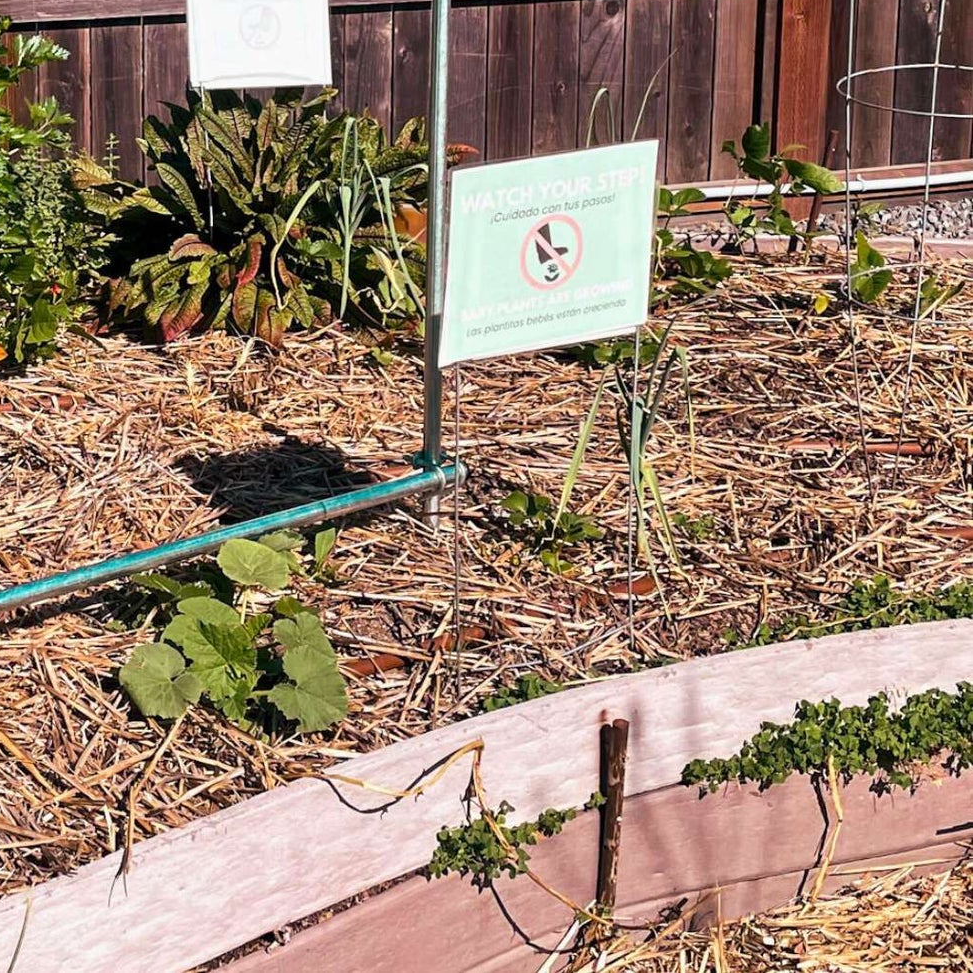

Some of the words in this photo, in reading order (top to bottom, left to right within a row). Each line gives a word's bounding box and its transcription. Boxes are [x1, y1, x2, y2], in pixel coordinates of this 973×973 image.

[460, 186, 533, 215] WATCH
[537, 175, 592, 200] YOUR
[598, 165, 647, 192] STEP!
[489, 208, 540, 226] ¡Cuidado
[541, 205, 562, 217] con
[564, 200, 581, 212] tus
[581, 192, 616, 211] pasos!
